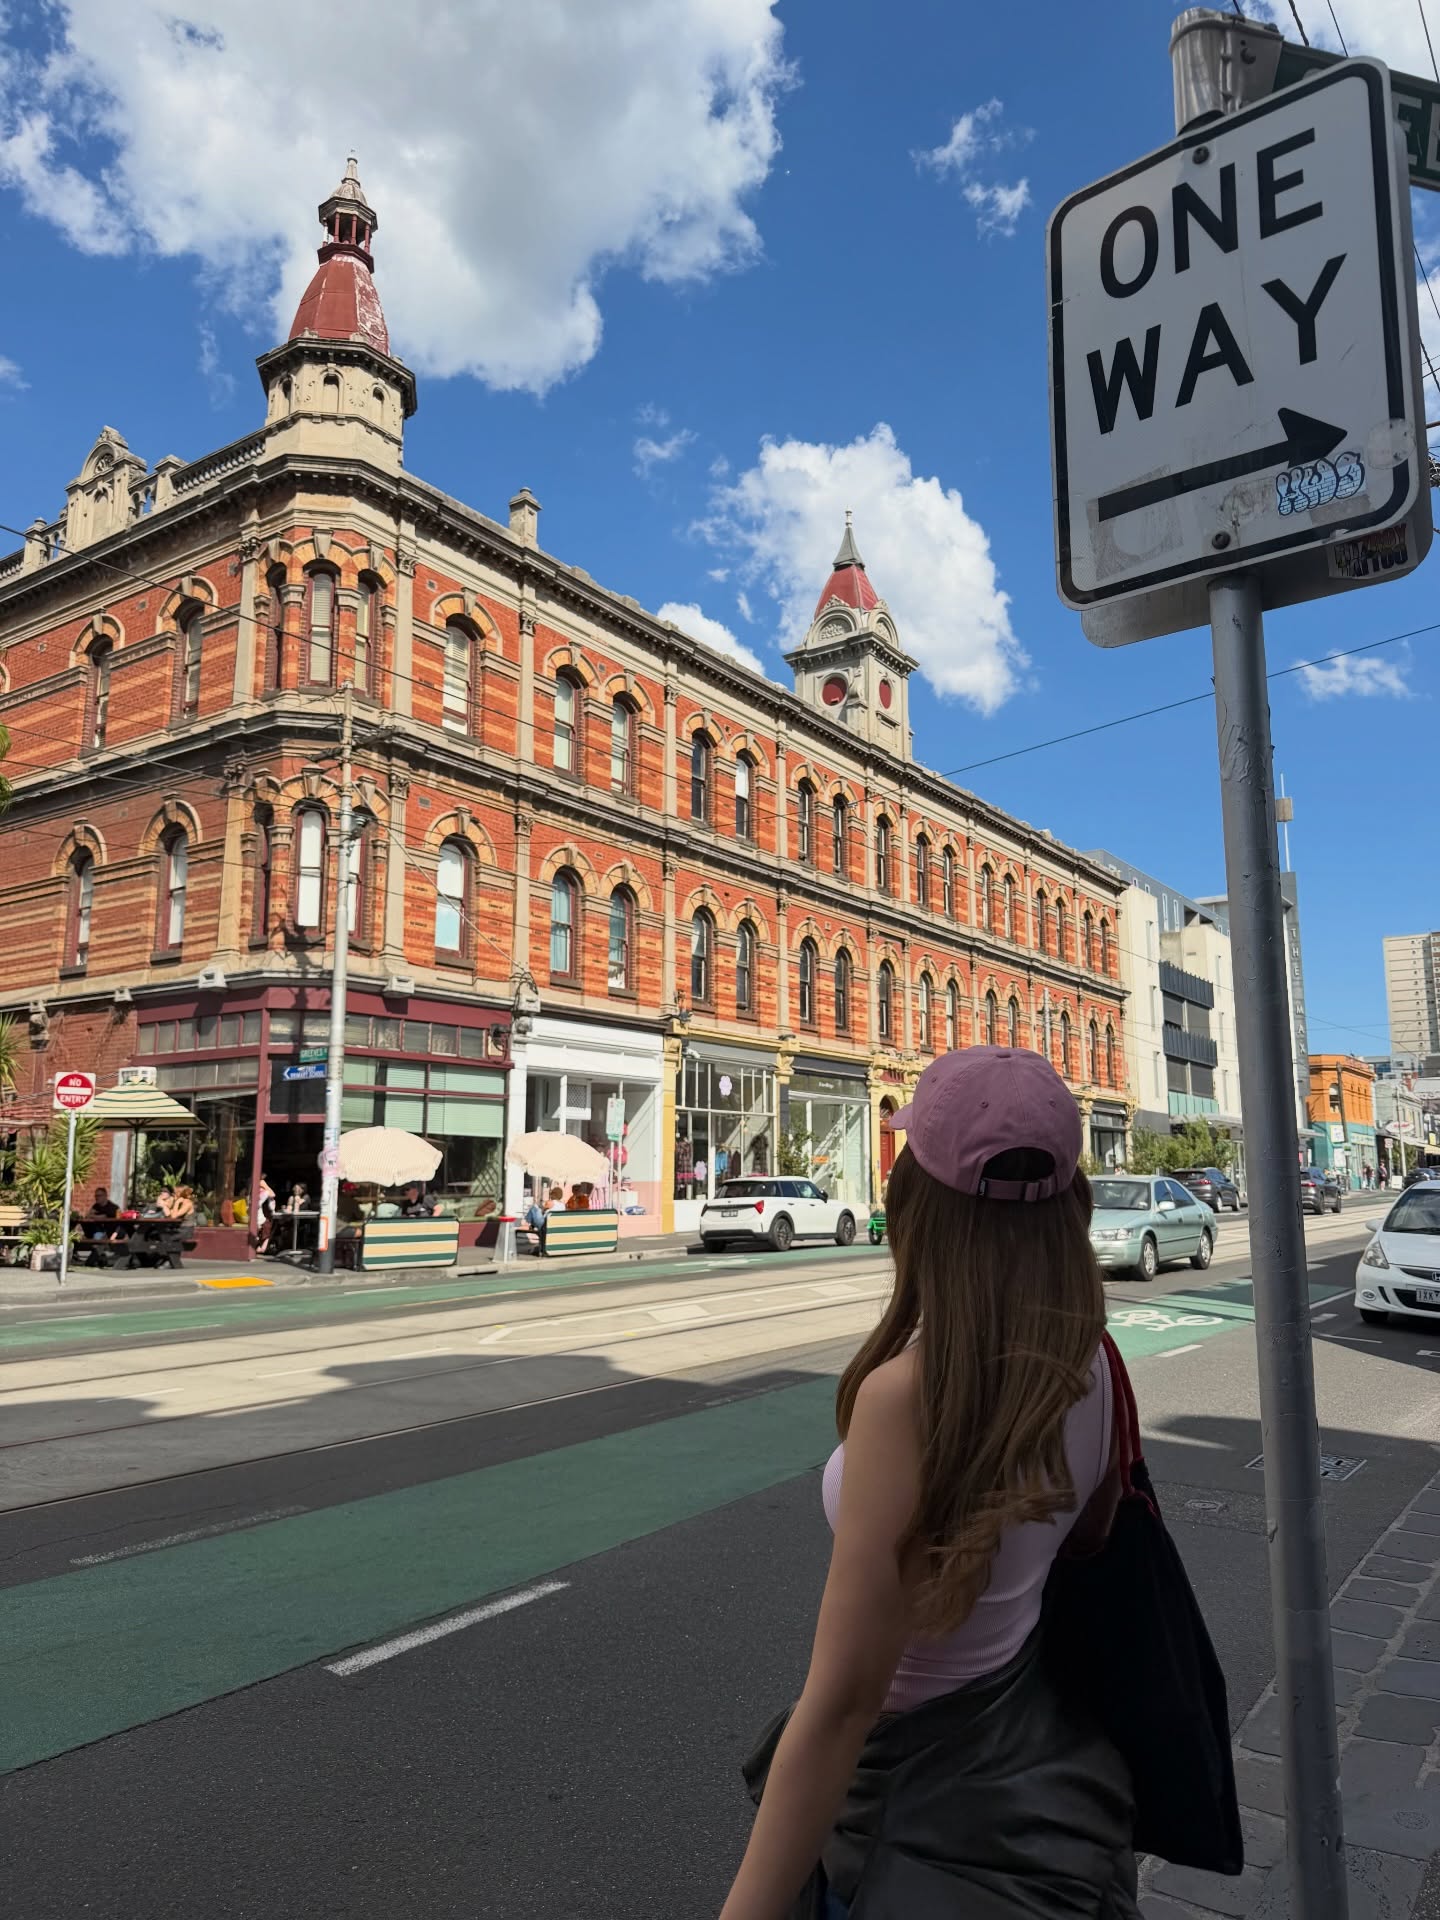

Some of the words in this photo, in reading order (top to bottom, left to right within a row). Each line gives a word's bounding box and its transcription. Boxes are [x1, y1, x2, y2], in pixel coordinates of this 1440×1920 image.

[1100, 127, 1323, 299] ONE
[1086, 253, 1348, 435] WAY
[1289, 928, 1301, 976] THE
[1295, 1004, 1306, 1054] MAX
[68, 1078, 82, 1087] NO
[310, 1070, 325, 1078] SCHOOL
[60, 1095, 88, 1104] ENTRY
